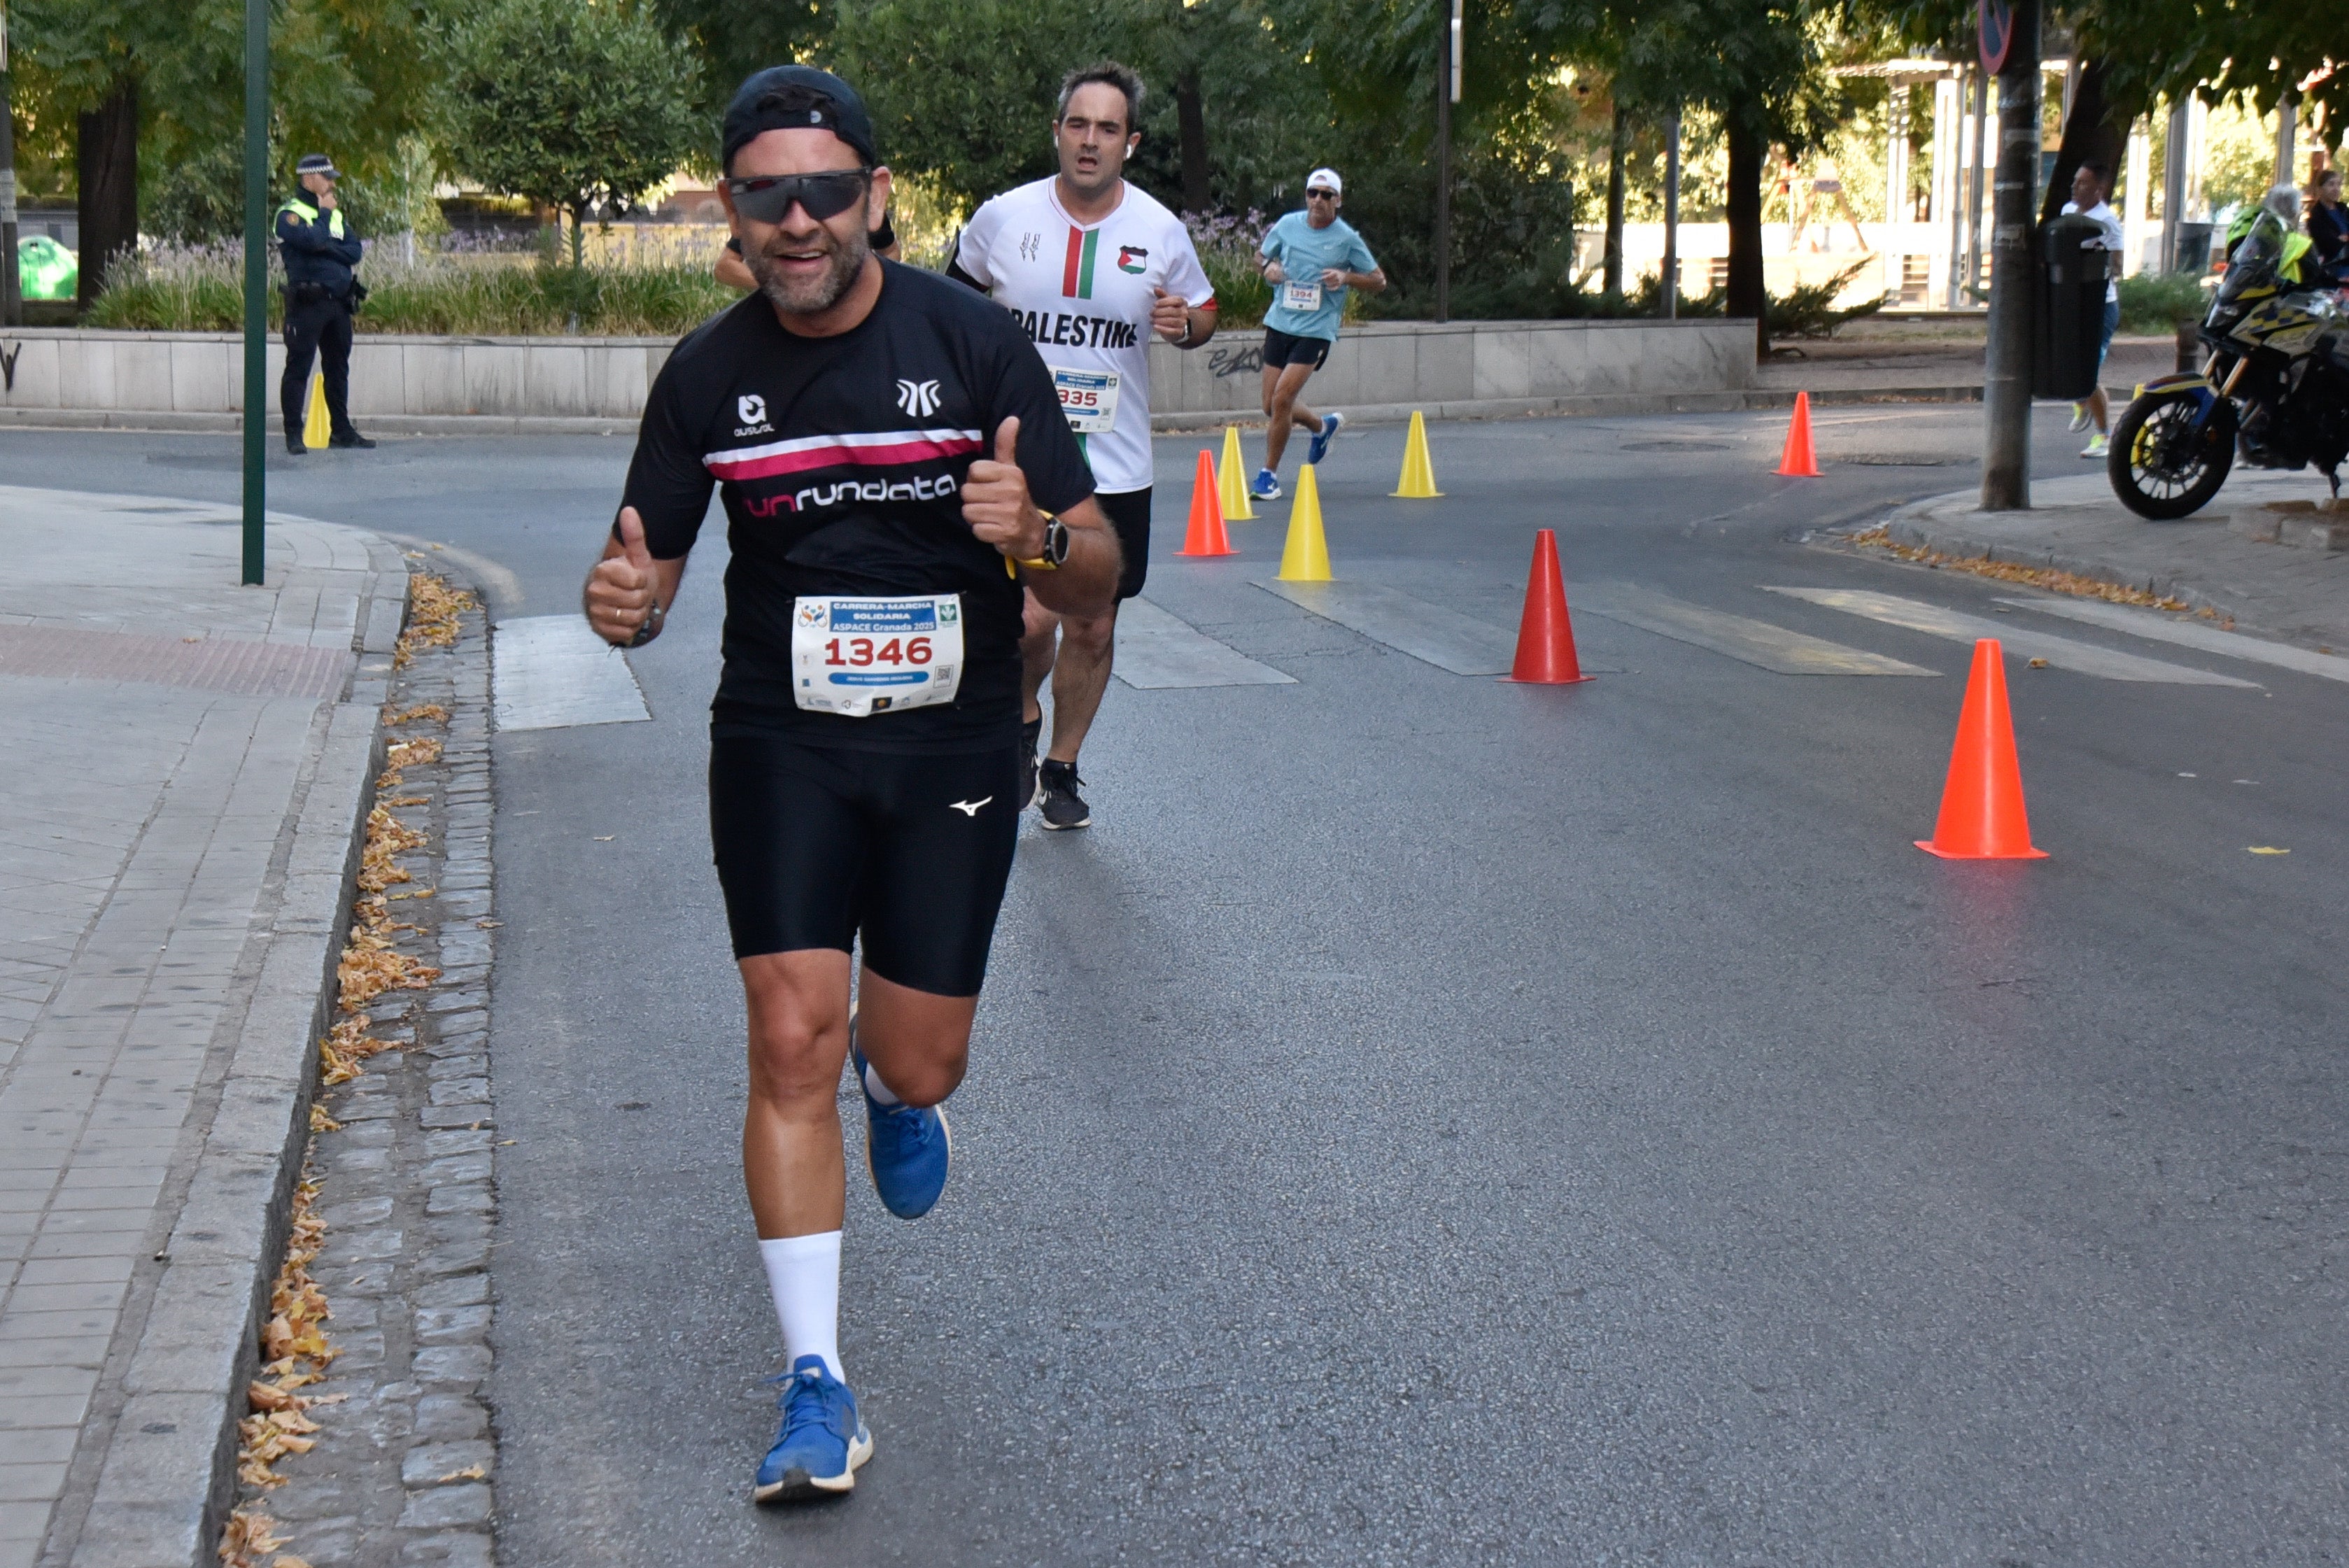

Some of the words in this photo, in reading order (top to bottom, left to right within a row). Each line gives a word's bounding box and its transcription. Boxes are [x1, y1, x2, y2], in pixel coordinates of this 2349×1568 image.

[1011, 309, 1137, 348] PALESTINE
[833, 602, 932, 610] CARRERA-MARCHA
[873, 623, 912, 631] Granada
[914, 622, 934, 630] 2025
[825, 637, 933, 666] 1346
